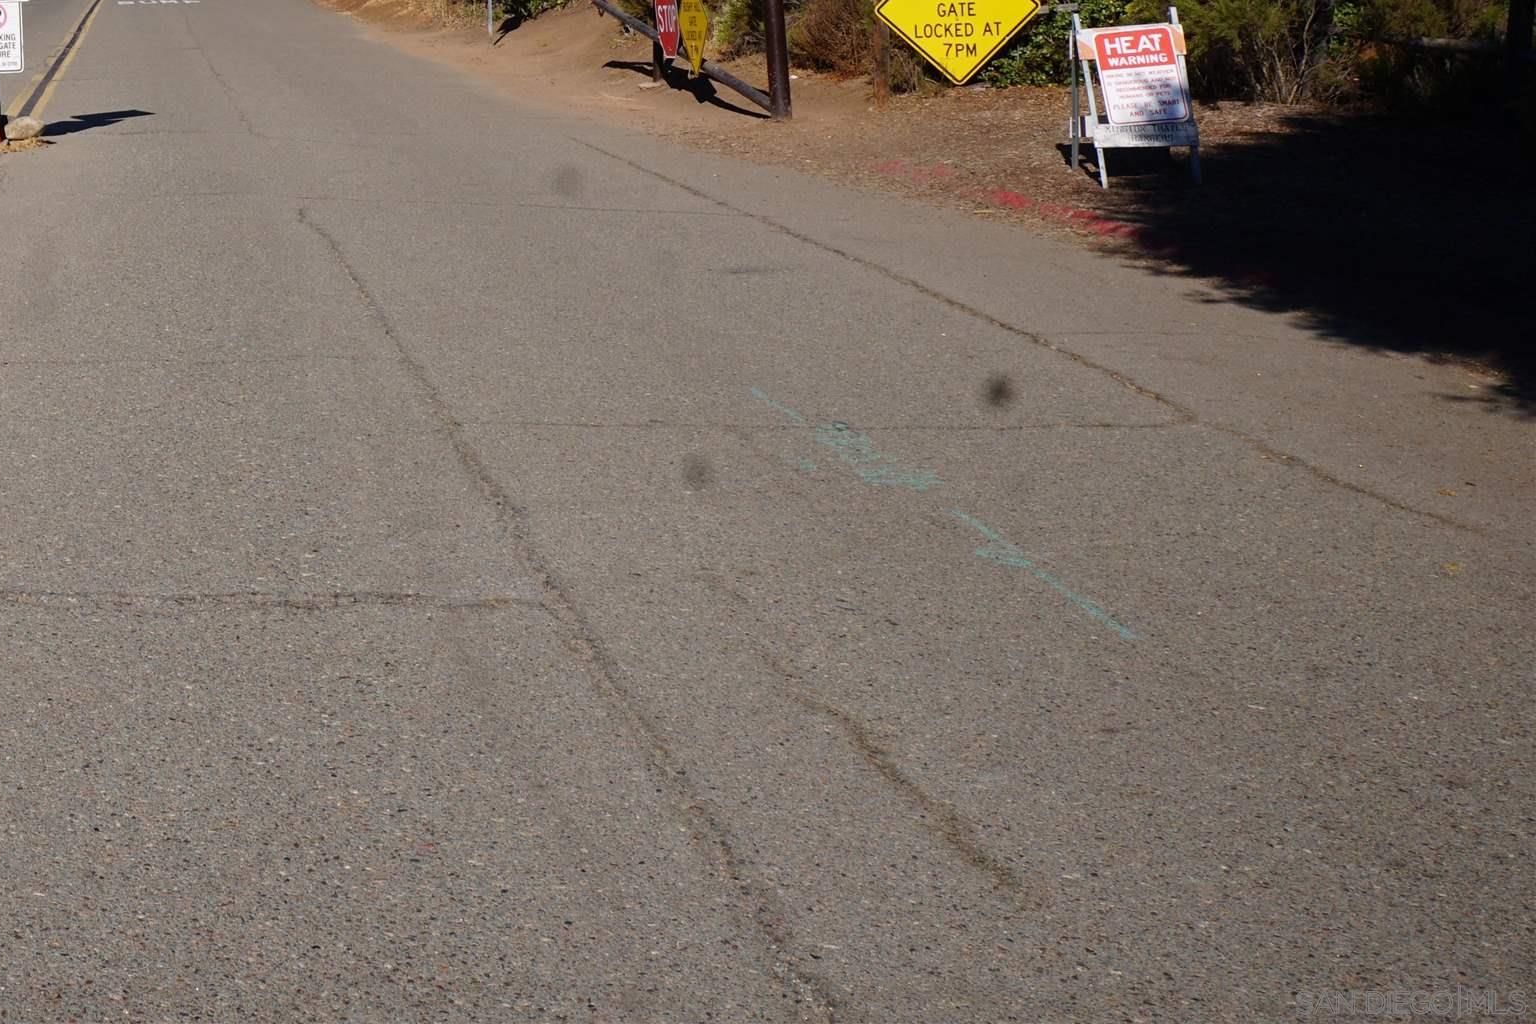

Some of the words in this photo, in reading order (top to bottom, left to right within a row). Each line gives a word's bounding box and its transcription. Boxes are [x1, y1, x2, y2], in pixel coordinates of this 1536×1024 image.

[937, 2, 976, 18] GATE
[658, 5, 676, 33] STOP
[914, 23, 975, 39] LOCKED
[982, 22, 1003, 37] AT
[943, 43, 978, 58] 7PM
[1104, 34, 1162, 56] HEAT
[1108, 53, 1168, 66] WARNING
